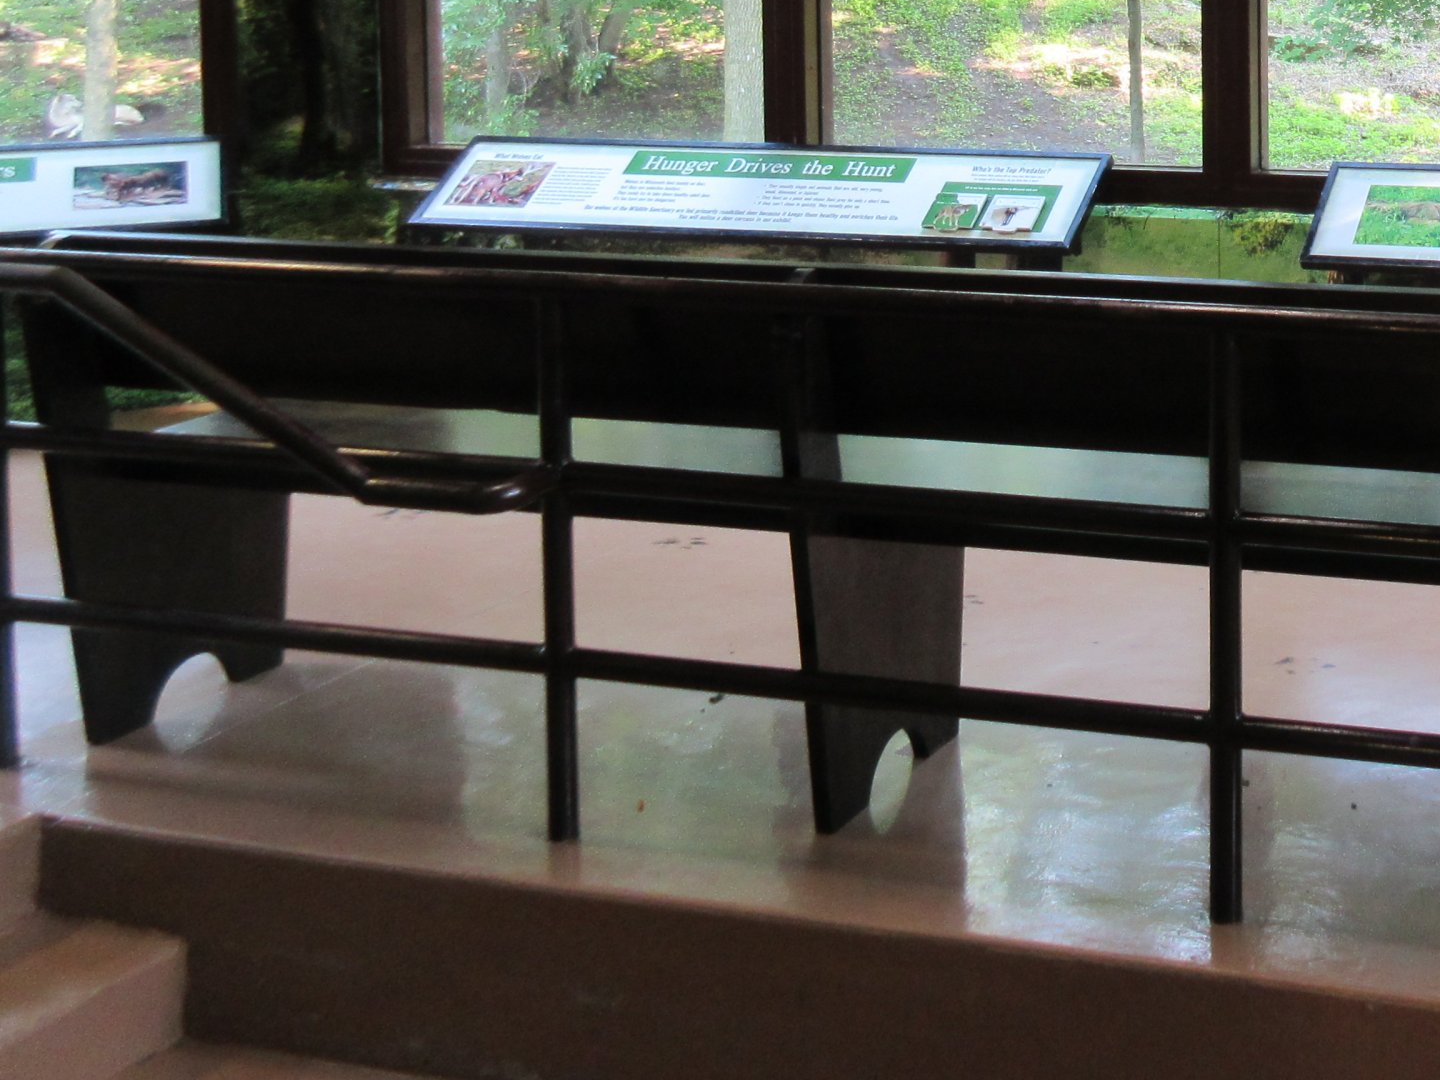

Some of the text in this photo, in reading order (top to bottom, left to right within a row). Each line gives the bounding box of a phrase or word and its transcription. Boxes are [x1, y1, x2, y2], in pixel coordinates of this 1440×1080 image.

[641, 156, 897, 177] Hunger Drives the Hunt
